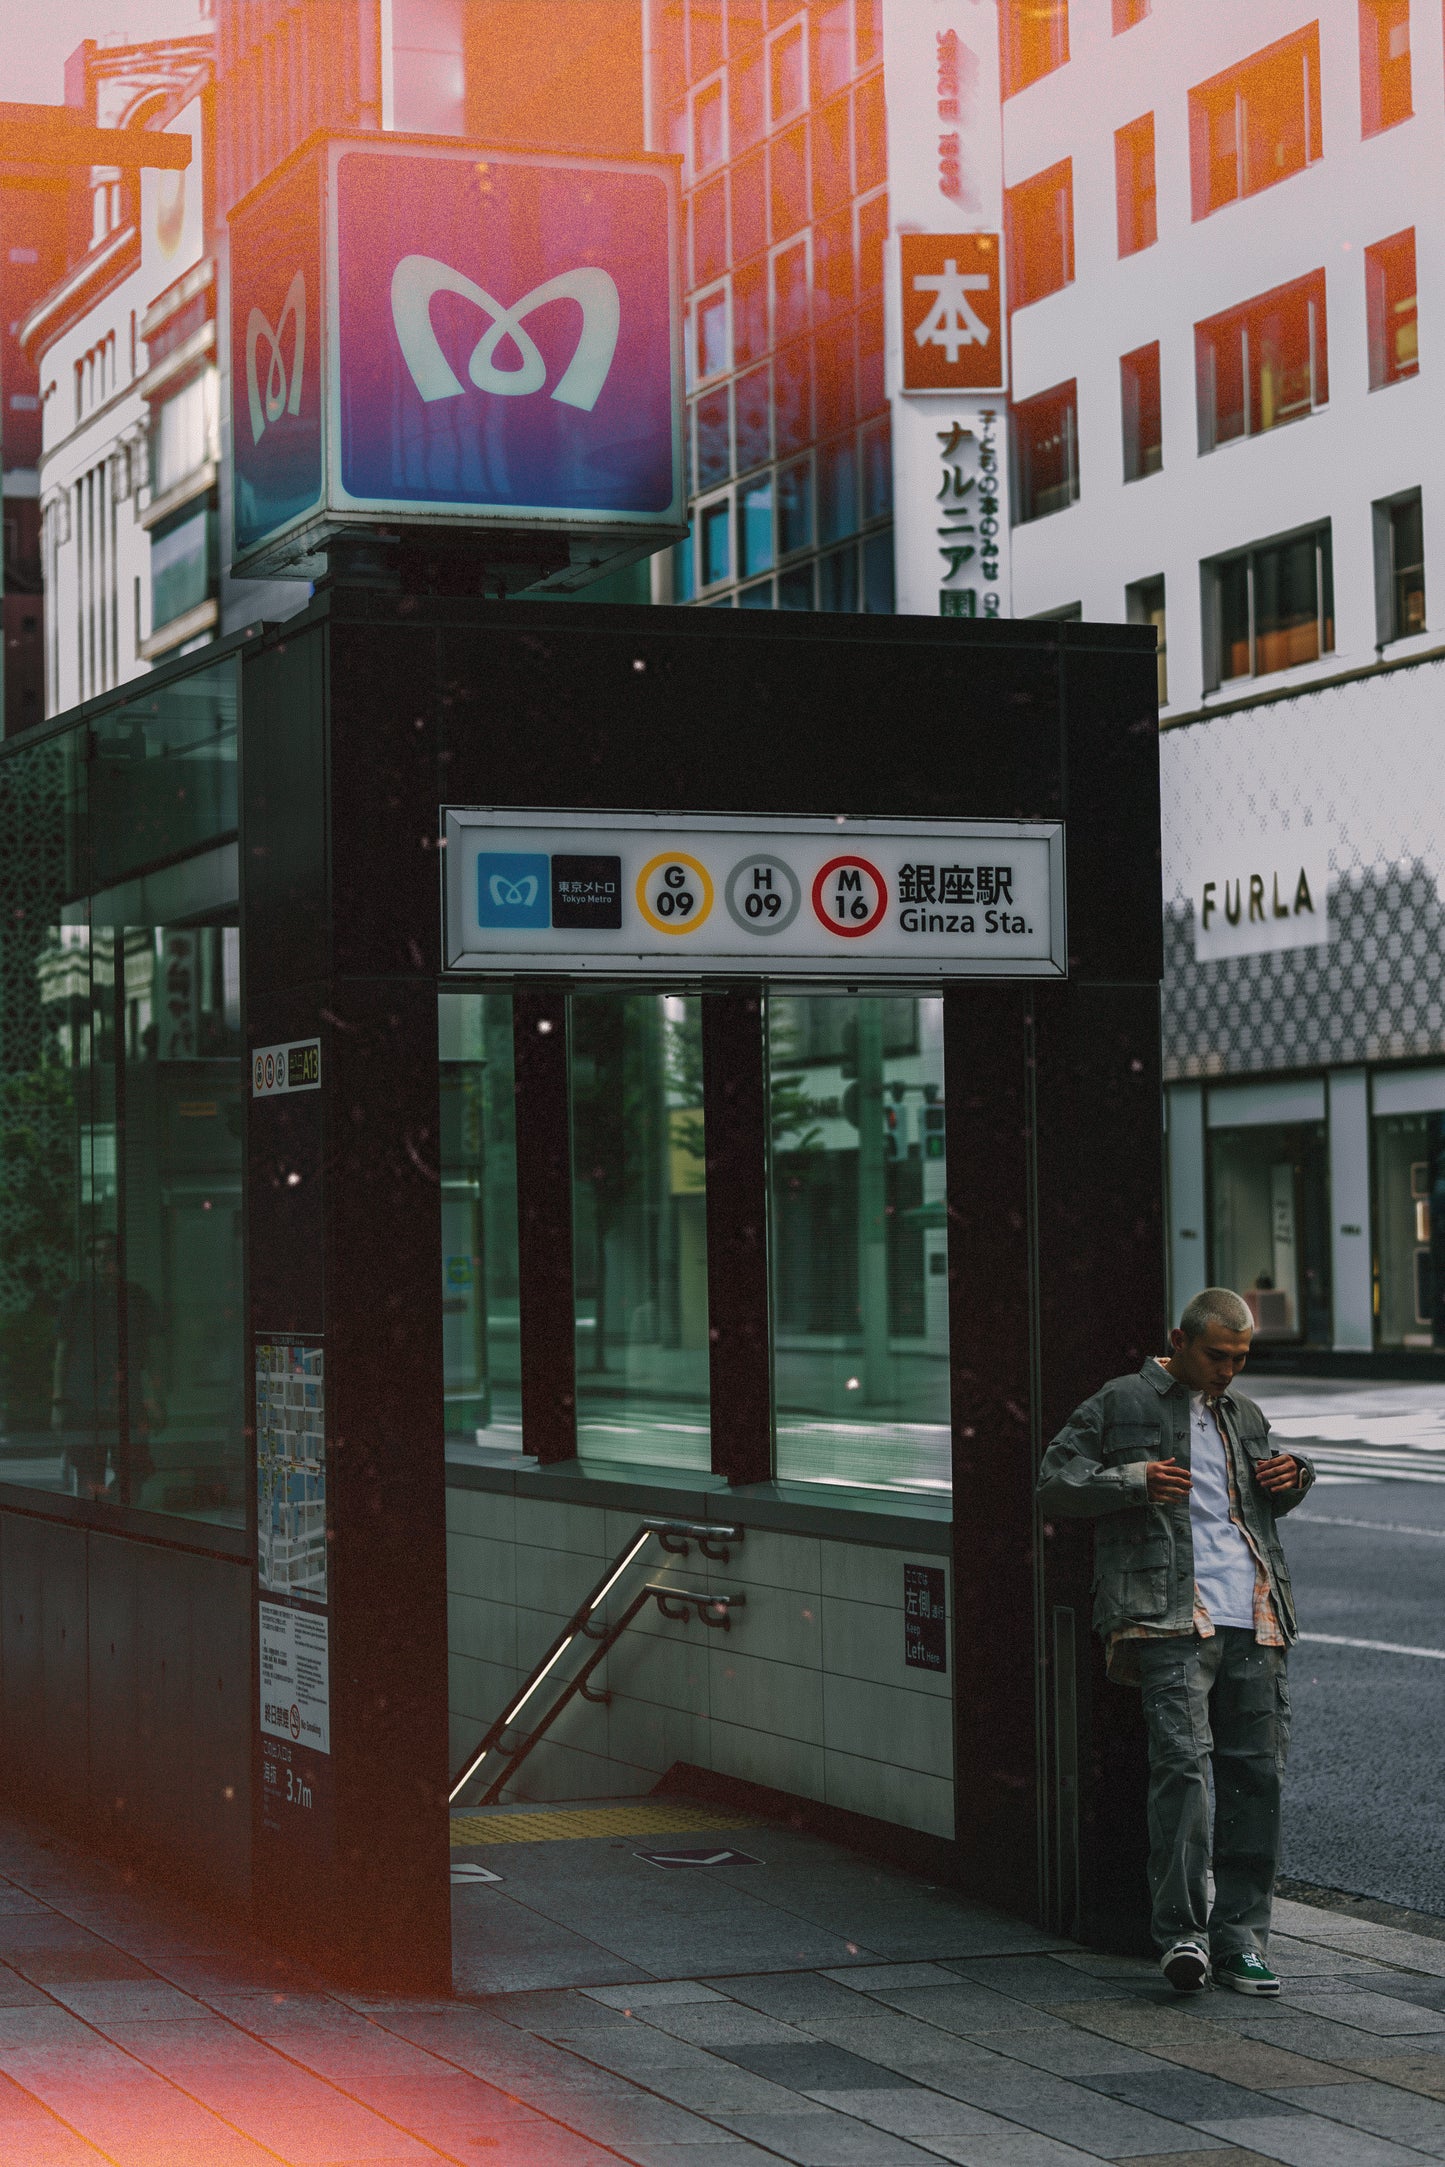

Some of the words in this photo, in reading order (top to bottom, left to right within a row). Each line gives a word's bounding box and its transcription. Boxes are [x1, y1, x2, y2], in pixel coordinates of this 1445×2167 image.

[913, 258, 990, 363] 本
[936, 421, 976, 617] ナルニア国
[558, 881, 616, 894] 東京メトロ
[664, 866, 686, 889] G
[753, 868, 772, 890] H
[838, 870, 862, 892] M
[898, 863, 1014, 905] 銀座駅
[561, 895, 586, 904] Tokyo
[587, 895, 612, 904] Metro
[656, 891, 694, 916] 09
[744, 893, 782, 918] 09
[835, 895, 869, 920] 16
[1202, 866, 1314, 931] FURLA
[899, 908, 975, 933] Ginza
[984, 910, 1033, 934] Sta.
[303, 1049, 318, 1080] A13
[907, 1623, 920, 1637] Keep
[907, 1640, 925, 1661] Left
[286, 1768, 312, 1809] 3.7m
